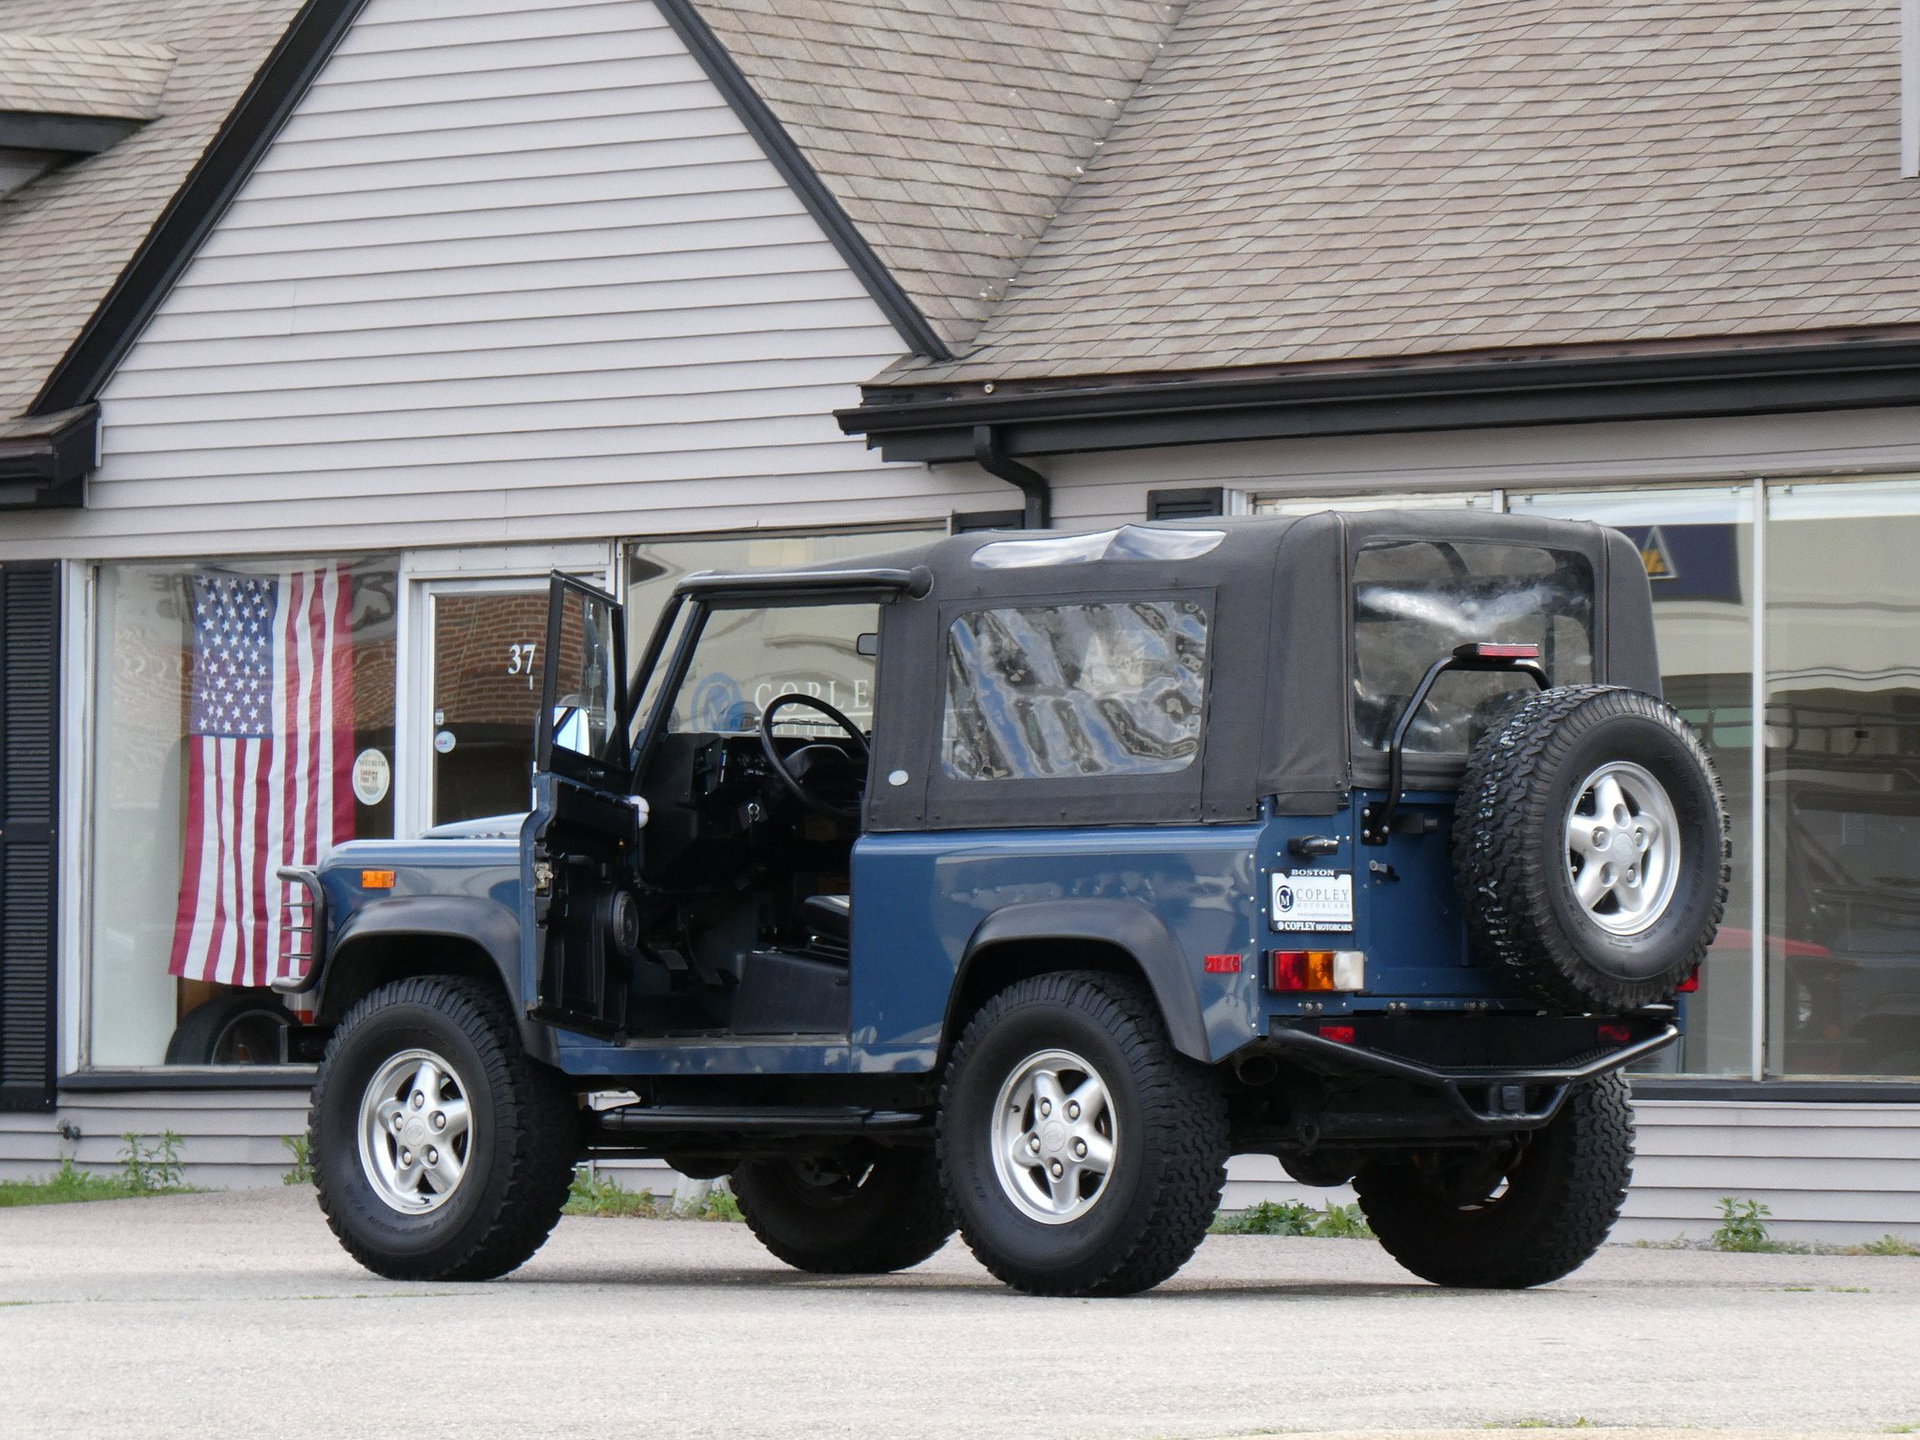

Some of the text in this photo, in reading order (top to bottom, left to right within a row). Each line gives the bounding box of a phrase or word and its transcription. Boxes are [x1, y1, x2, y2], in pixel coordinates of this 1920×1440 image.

[508, 643, 536, 675] 37
[754, 679, 872, 713] COPLE
[1296, 888, 1349, 901] COPLEY
[1284, 922, 1353, 931] COPLEY MOTORCARS
